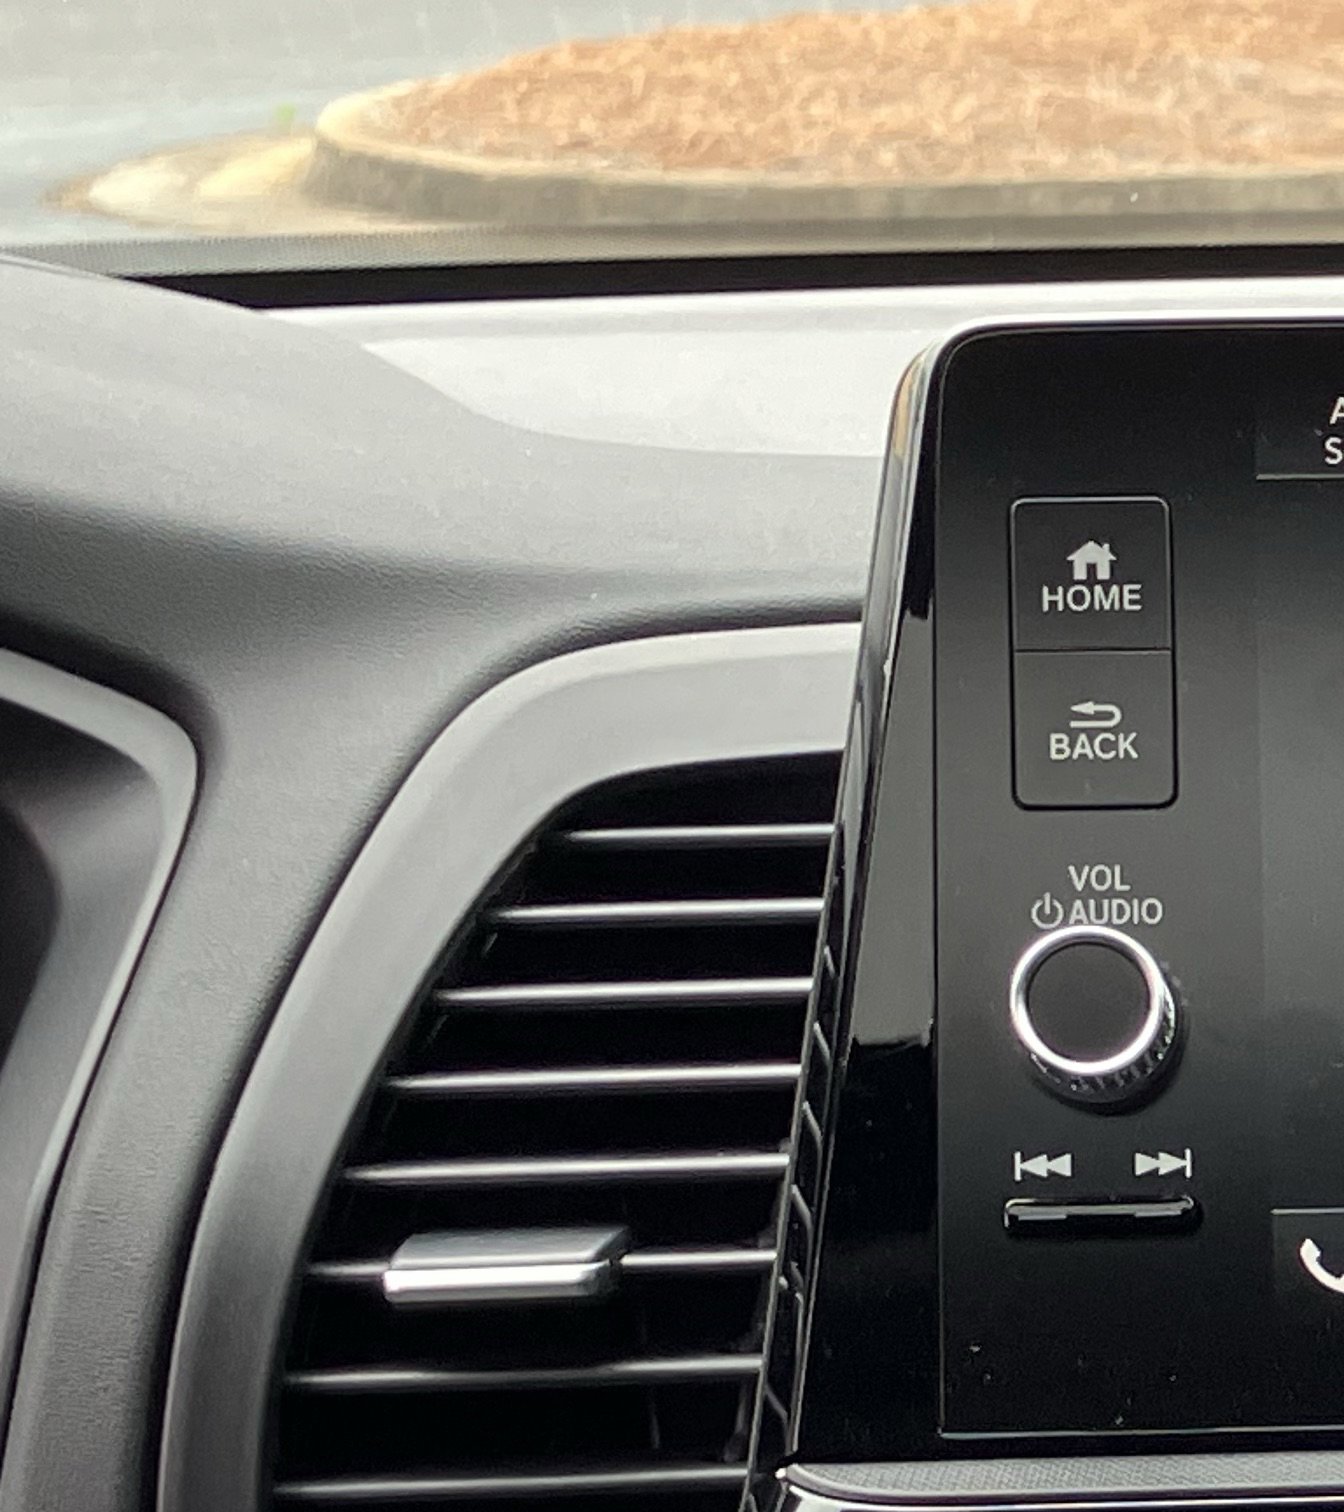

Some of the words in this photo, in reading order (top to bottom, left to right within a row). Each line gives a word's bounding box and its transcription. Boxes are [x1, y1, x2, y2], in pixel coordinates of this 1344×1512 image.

[1042, 583, 1142, 612] HOME
[1049, 732, 1139, 760] BACK
[1067, 864, 1131, 892] VOL
[1068, 897, 1164, 926] AUDIO
